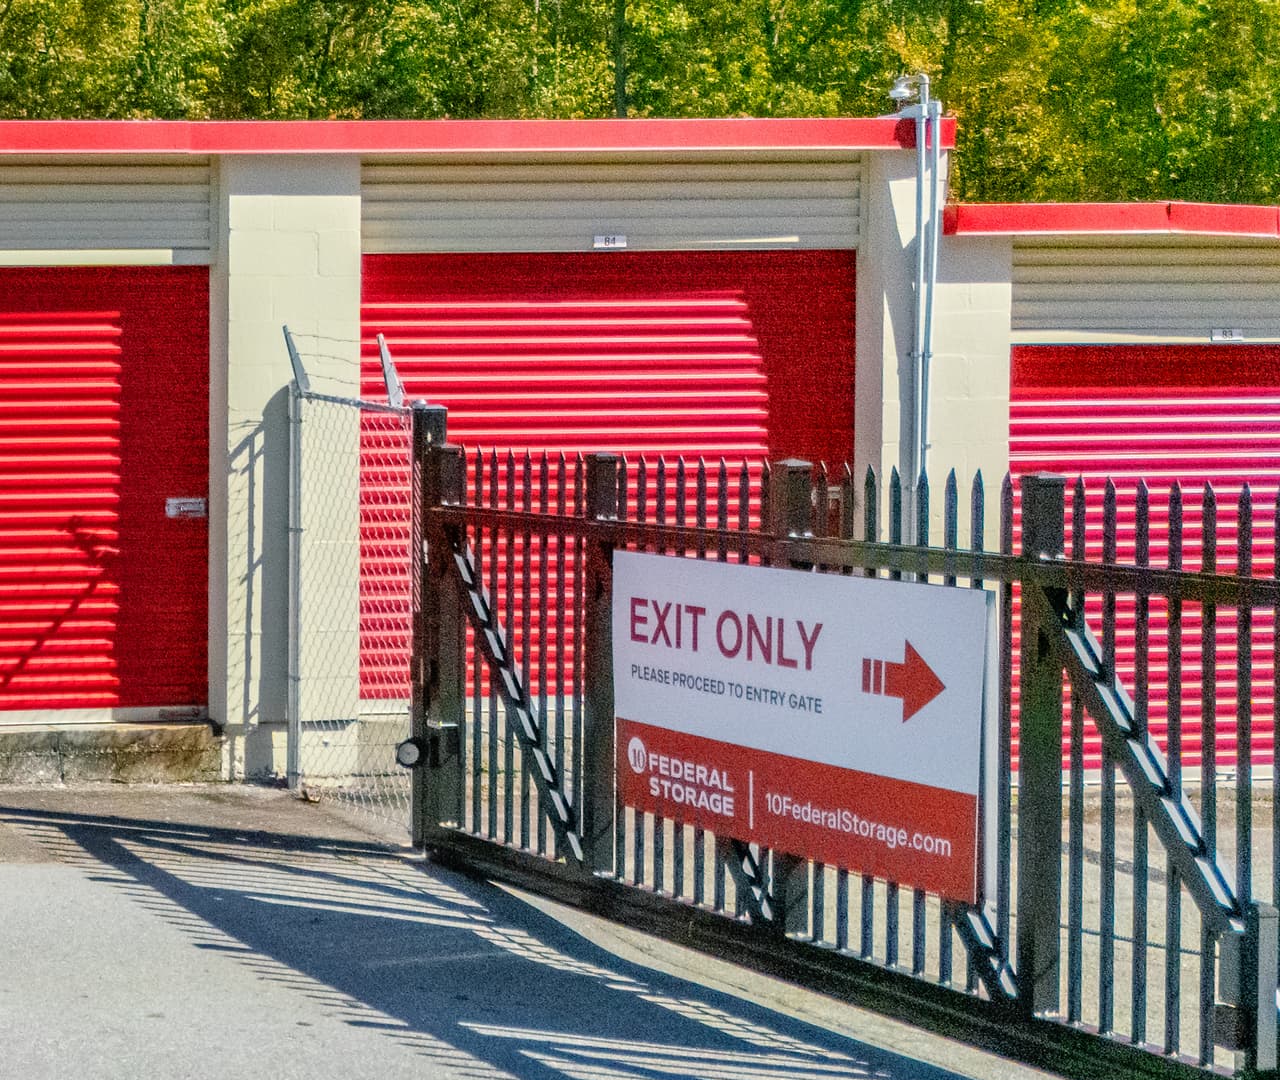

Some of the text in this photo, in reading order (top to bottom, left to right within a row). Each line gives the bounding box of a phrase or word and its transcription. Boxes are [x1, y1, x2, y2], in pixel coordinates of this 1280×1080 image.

[630, 597, 823, 671] EXIT ONLY
[631, 664, 822, 714] PLEASE PROCEED TO ENTRY GATE
[649, 753, 734, 792] FEDERAL
[648, 779, 734, 817] STORAGE
[764, 791, 952, 857] 10FederalStorage.com
